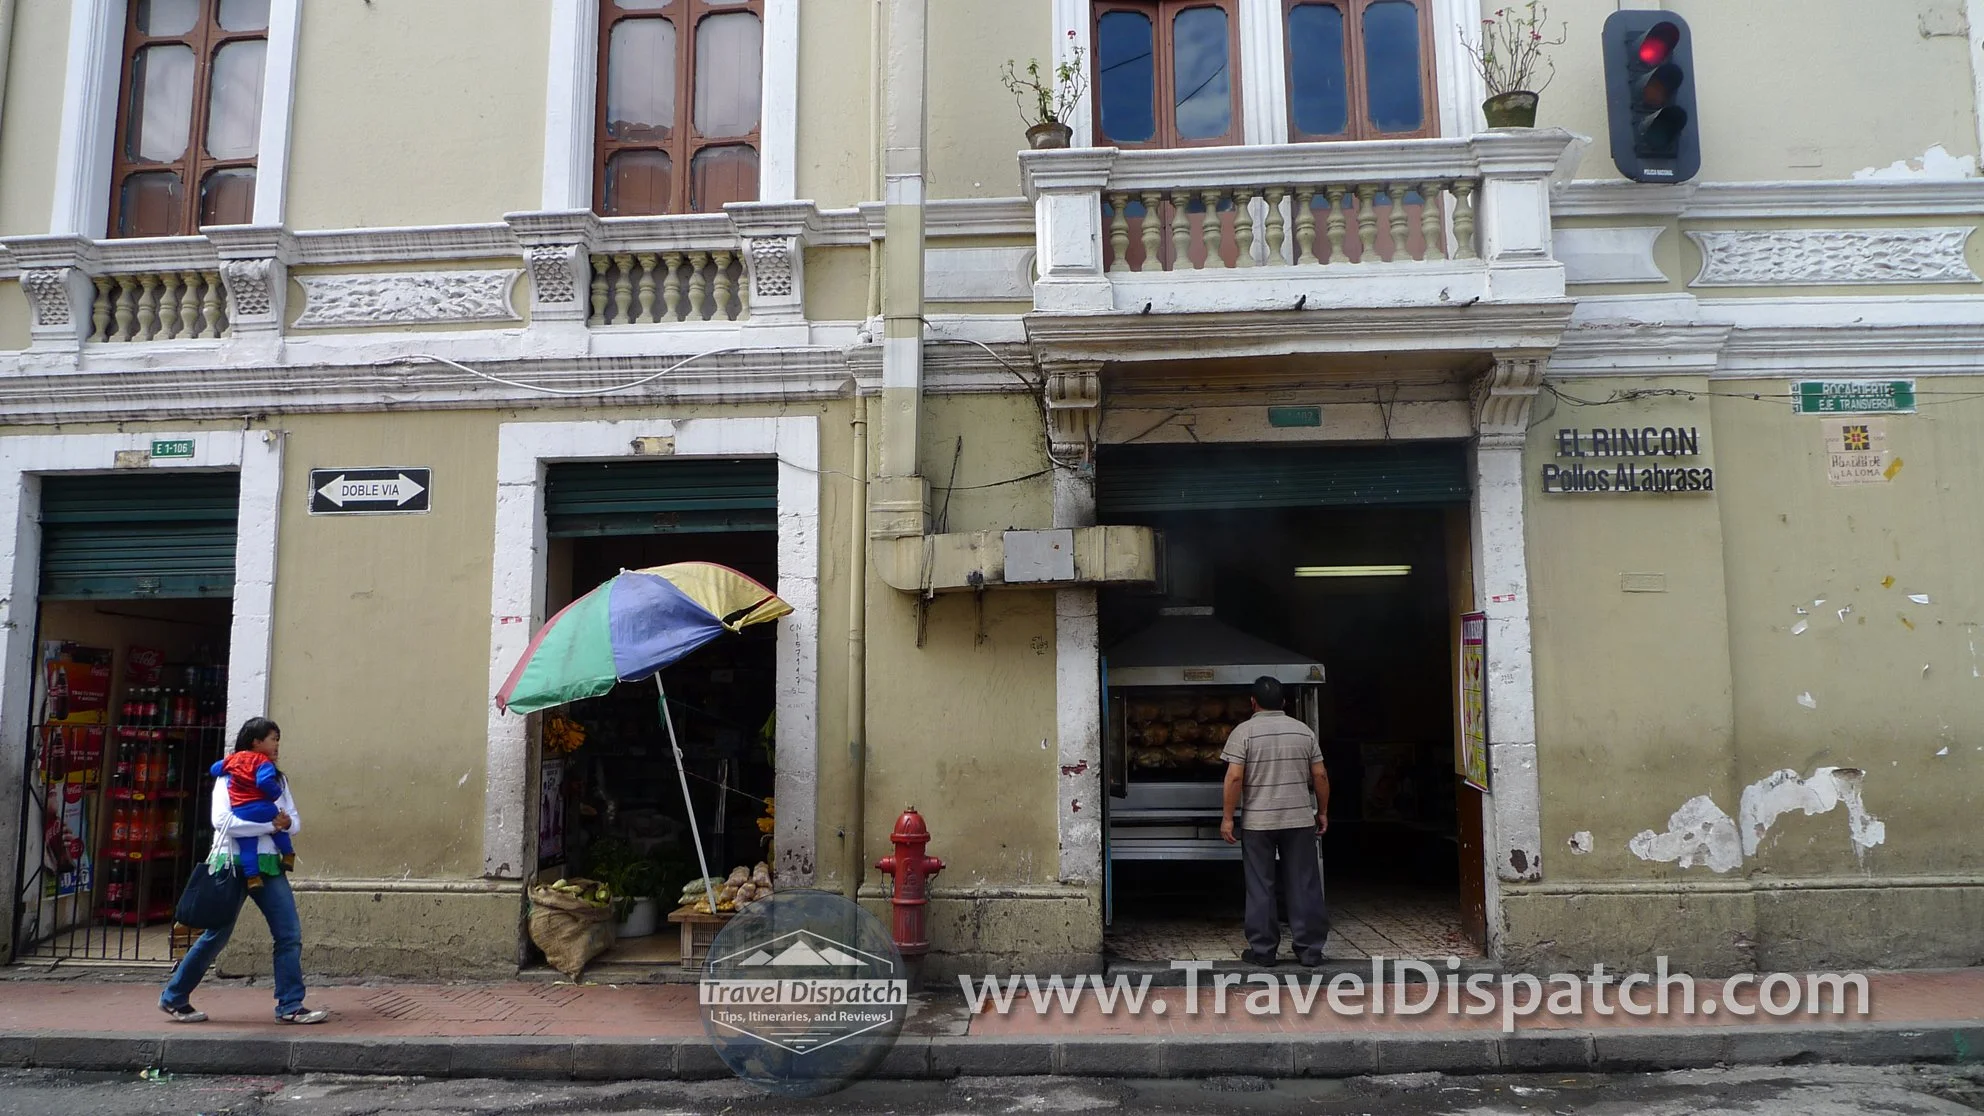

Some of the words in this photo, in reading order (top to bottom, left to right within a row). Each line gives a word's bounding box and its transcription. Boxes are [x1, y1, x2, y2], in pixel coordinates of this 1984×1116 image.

[1822, 383, 1895, 398] ROCAFUERTE
[1839, 398, 1898, 410] TRANSVERSAL
[1558, 428, 1585, 457] EL
[1592, 426, 1698, 457] RINCON
[156, 443, 163, 454] E
[164, 443, 188, 454] 1-106
[1542, 463, 1610, 493] Pollos
[1855, 469, 1881, 477] LOMA
[341, 485, 379, 497] DOBLE
[381, 484, 400, 496] VIA
